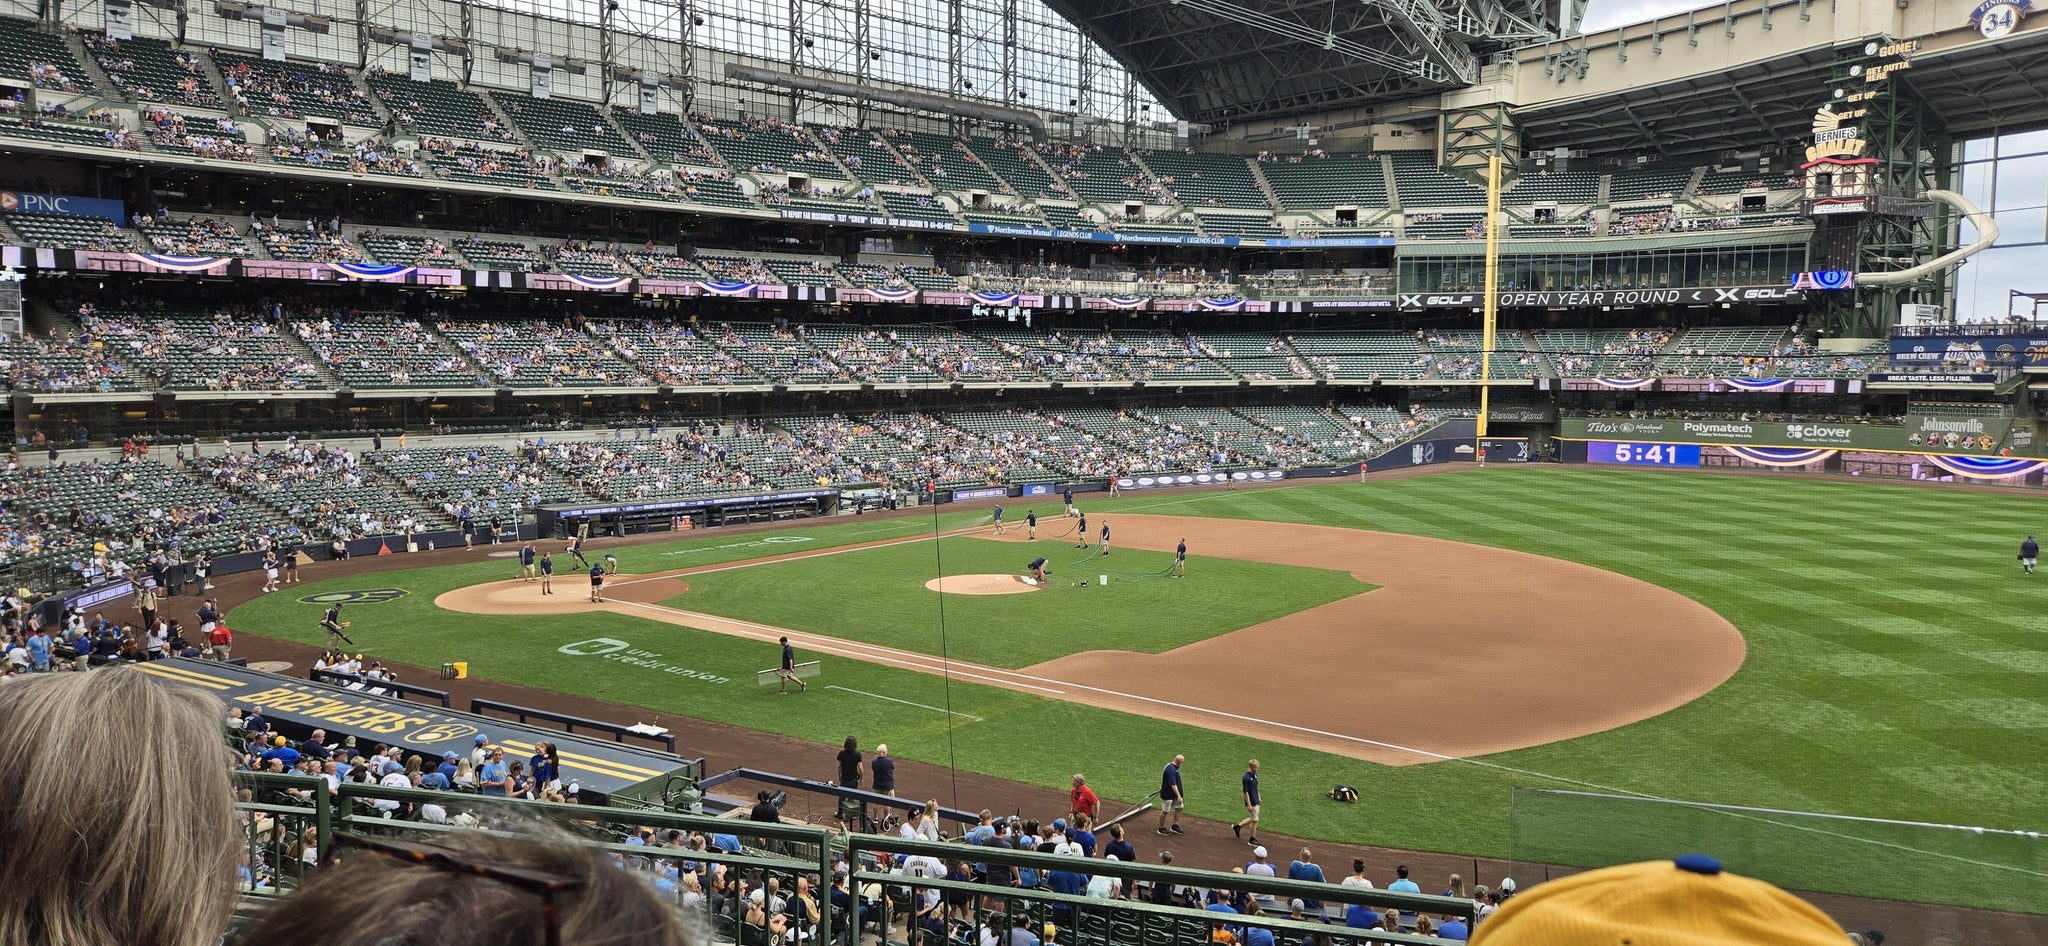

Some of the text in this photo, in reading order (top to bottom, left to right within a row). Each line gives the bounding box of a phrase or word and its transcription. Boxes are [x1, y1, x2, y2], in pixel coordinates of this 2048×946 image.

[1985, 9, 2012, 33] 34
[1880, 41, 1917, 57] GONE!
[1866, 62, 1909, 76] GET OUTTA
[1866, 72, 1888, 82] HERE
[1848, 91, 1877, 102] GET UP
[1838, 109, 1867, 120] GET UP
[1816, 127, 1856, 143] BERNIE'S
[1806, 139, 1866, 162] CHALET
[22, 194, 70, 213] PNC
[995, 225, 1032, 235] Northwestern
[1033, 228, 1052, 237] Mutual
[1057, 230, 1080, 239] LEGENDS
[1122, 235, 1160, 243] Northwestern
[1400, 294, 1473, 307] X GOLF
[1500, 290, 1680, 306] OPEN YEAR ROUND
[1714, 288, 1799, 302] X GOLF
[1896, 352, 1918, 360] BREW
[1919, 352, 1940, 360] CREW
[1913, 345, 1924, 353] GO
[1490, 411, 1544, 422] Barrel Yard
[1587, 422, 1618, 433] Tito's
[1684, 422, 1753, 435] Polymatech
[1803, 424, 1851, 437] clover
[1920, 417, 1983, 433] Johnsonville
[1615, 444, 1676, 464] 5:41
[604, 652, 730, 684] credit union
[233, 687, 429, 734] BREWERS
[915, 869, 923, 878] 11
